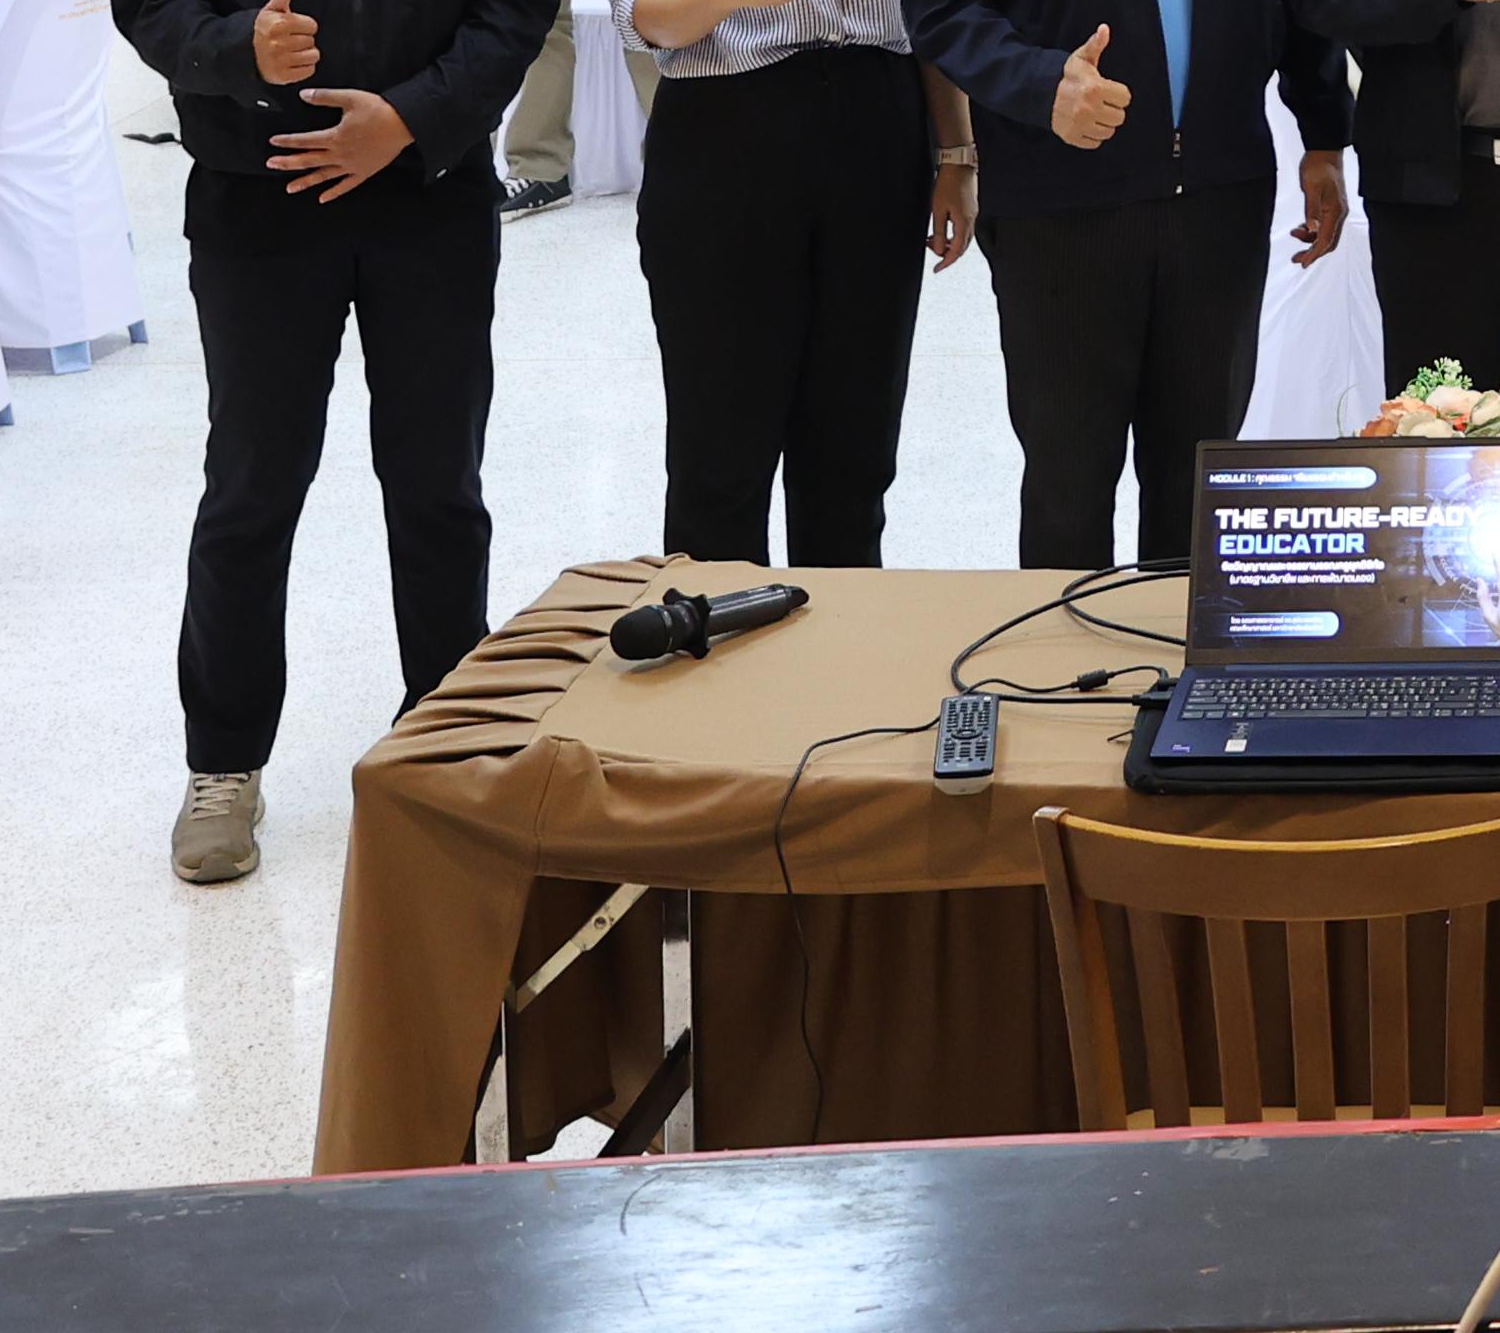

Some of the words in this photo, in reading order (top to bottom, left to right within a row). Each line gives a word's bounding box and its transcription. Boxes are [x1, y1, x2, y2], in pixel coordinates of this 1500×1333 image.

[1215, 508, 1268, 530] THE
[1273, 505, 1481, 530] FUTURE-READY
[1219, 533, 1365, 555] EDUCATOR
